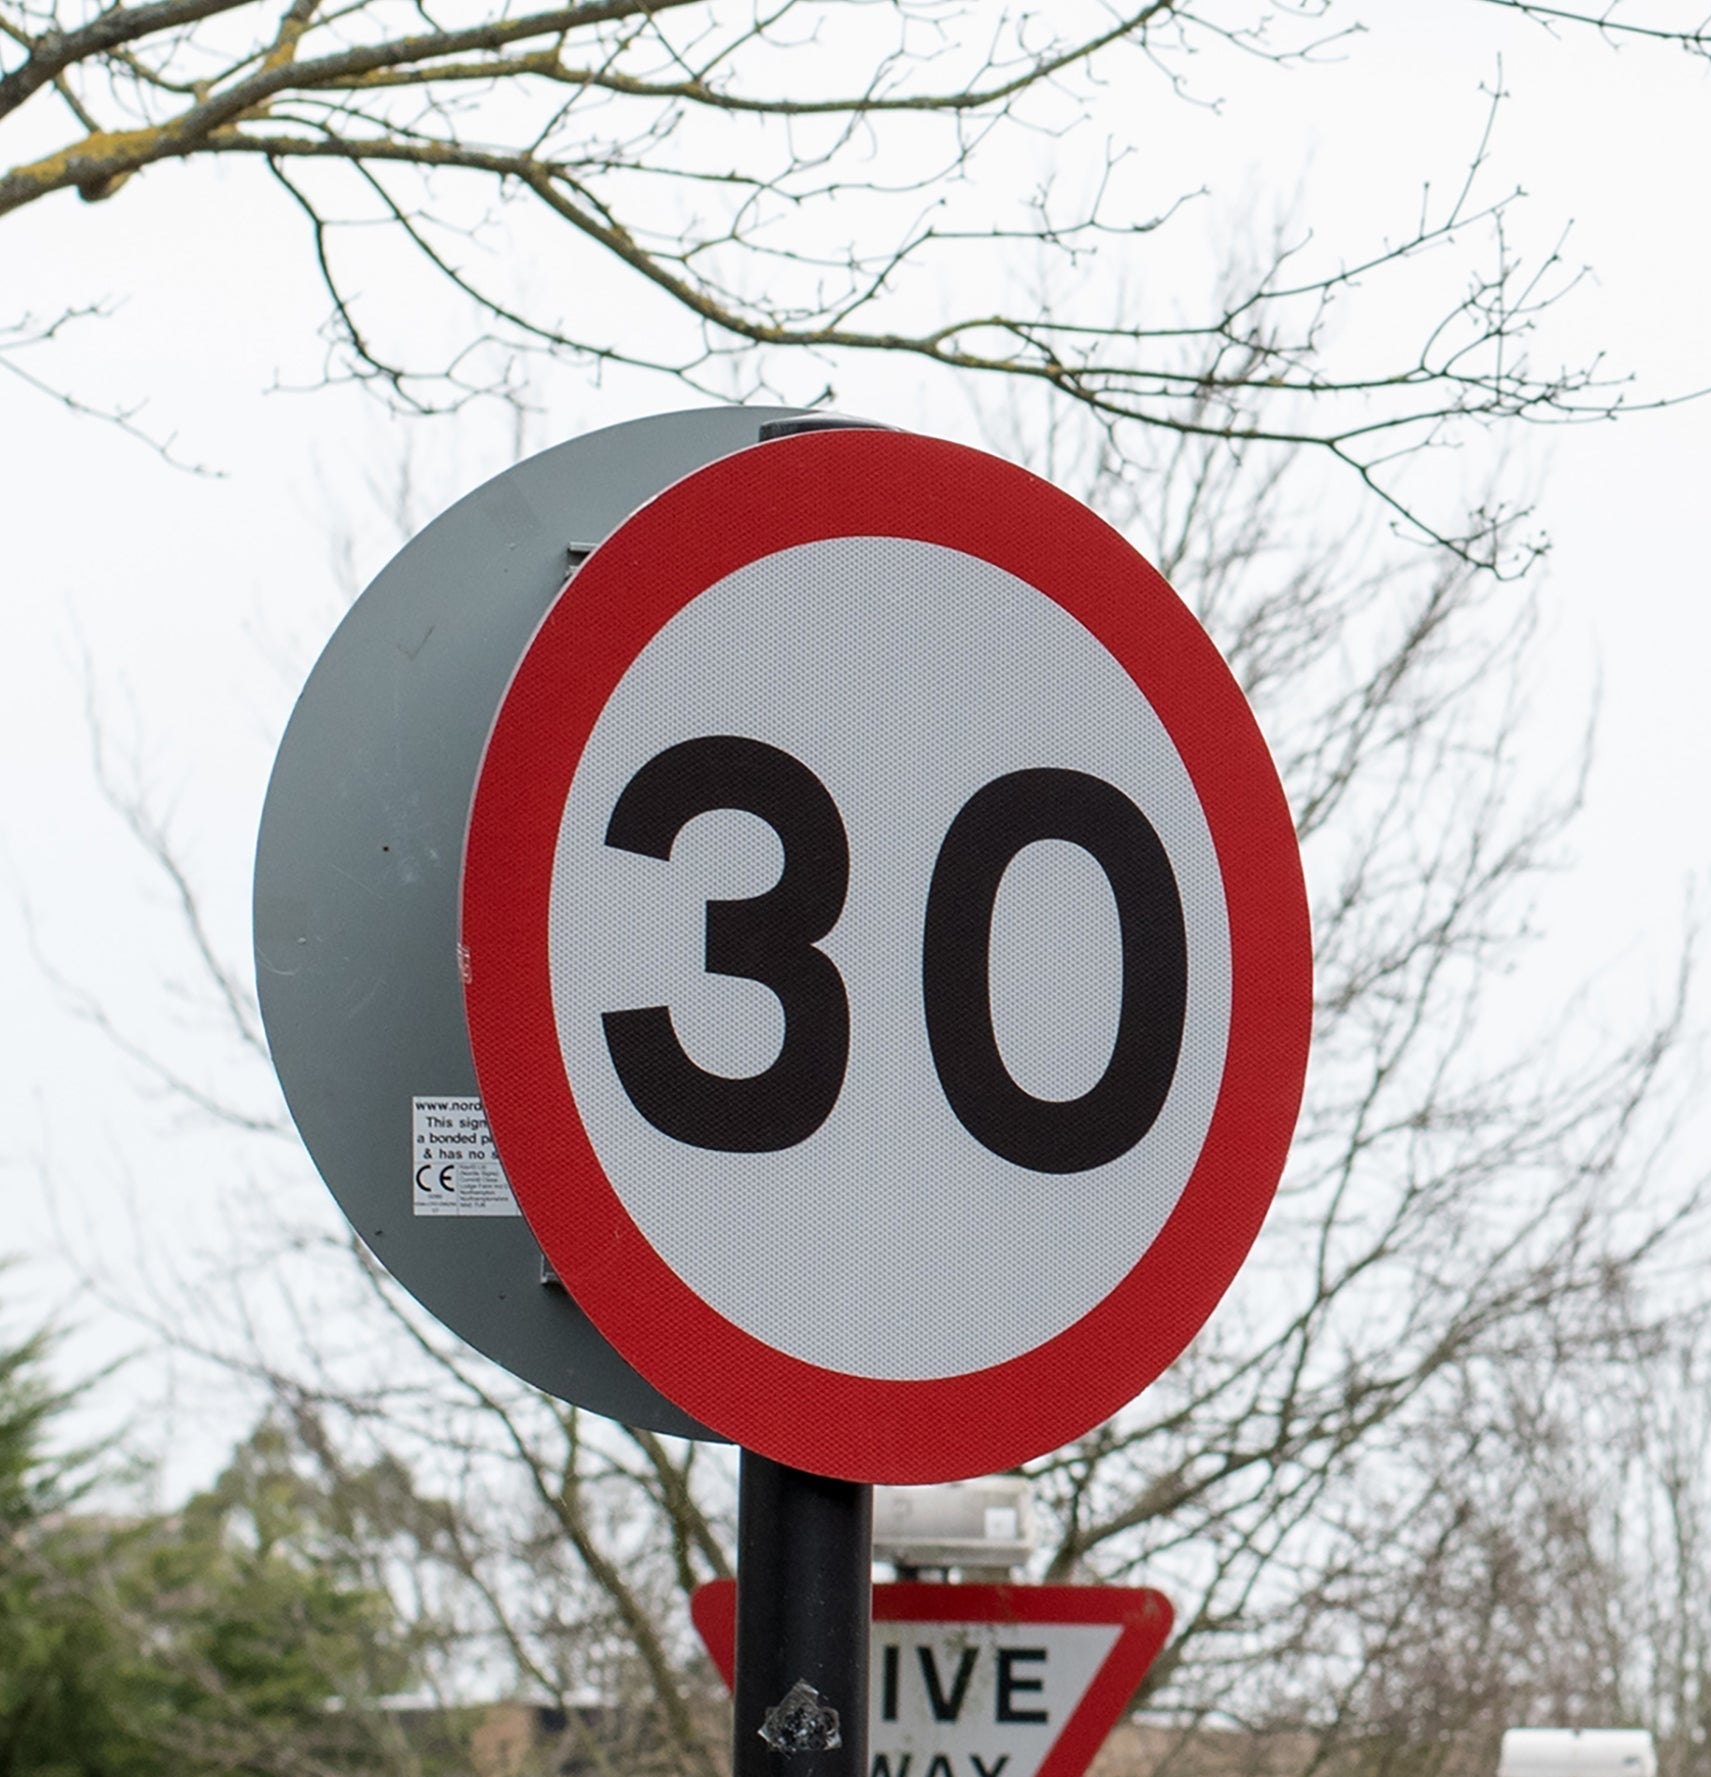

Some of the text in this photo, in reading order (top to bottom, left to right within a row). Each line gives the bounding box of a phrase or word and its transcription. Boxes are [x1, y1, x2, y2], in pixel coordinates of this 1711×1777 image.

[601, 735, 1188, 1174] 30
[426, 1116, 453, 1127] This
[417, 1134, 425, 1143] a
[429, 1132, 476, 1143] bonded
[423, 1148, 432, 1159] &
[439, 1148, 463, 1159] has
[469, 1150, 485, 1159] no
[416, 1164, 455, 1192] CE
[883, 1645, 1048, 1723] IVE
